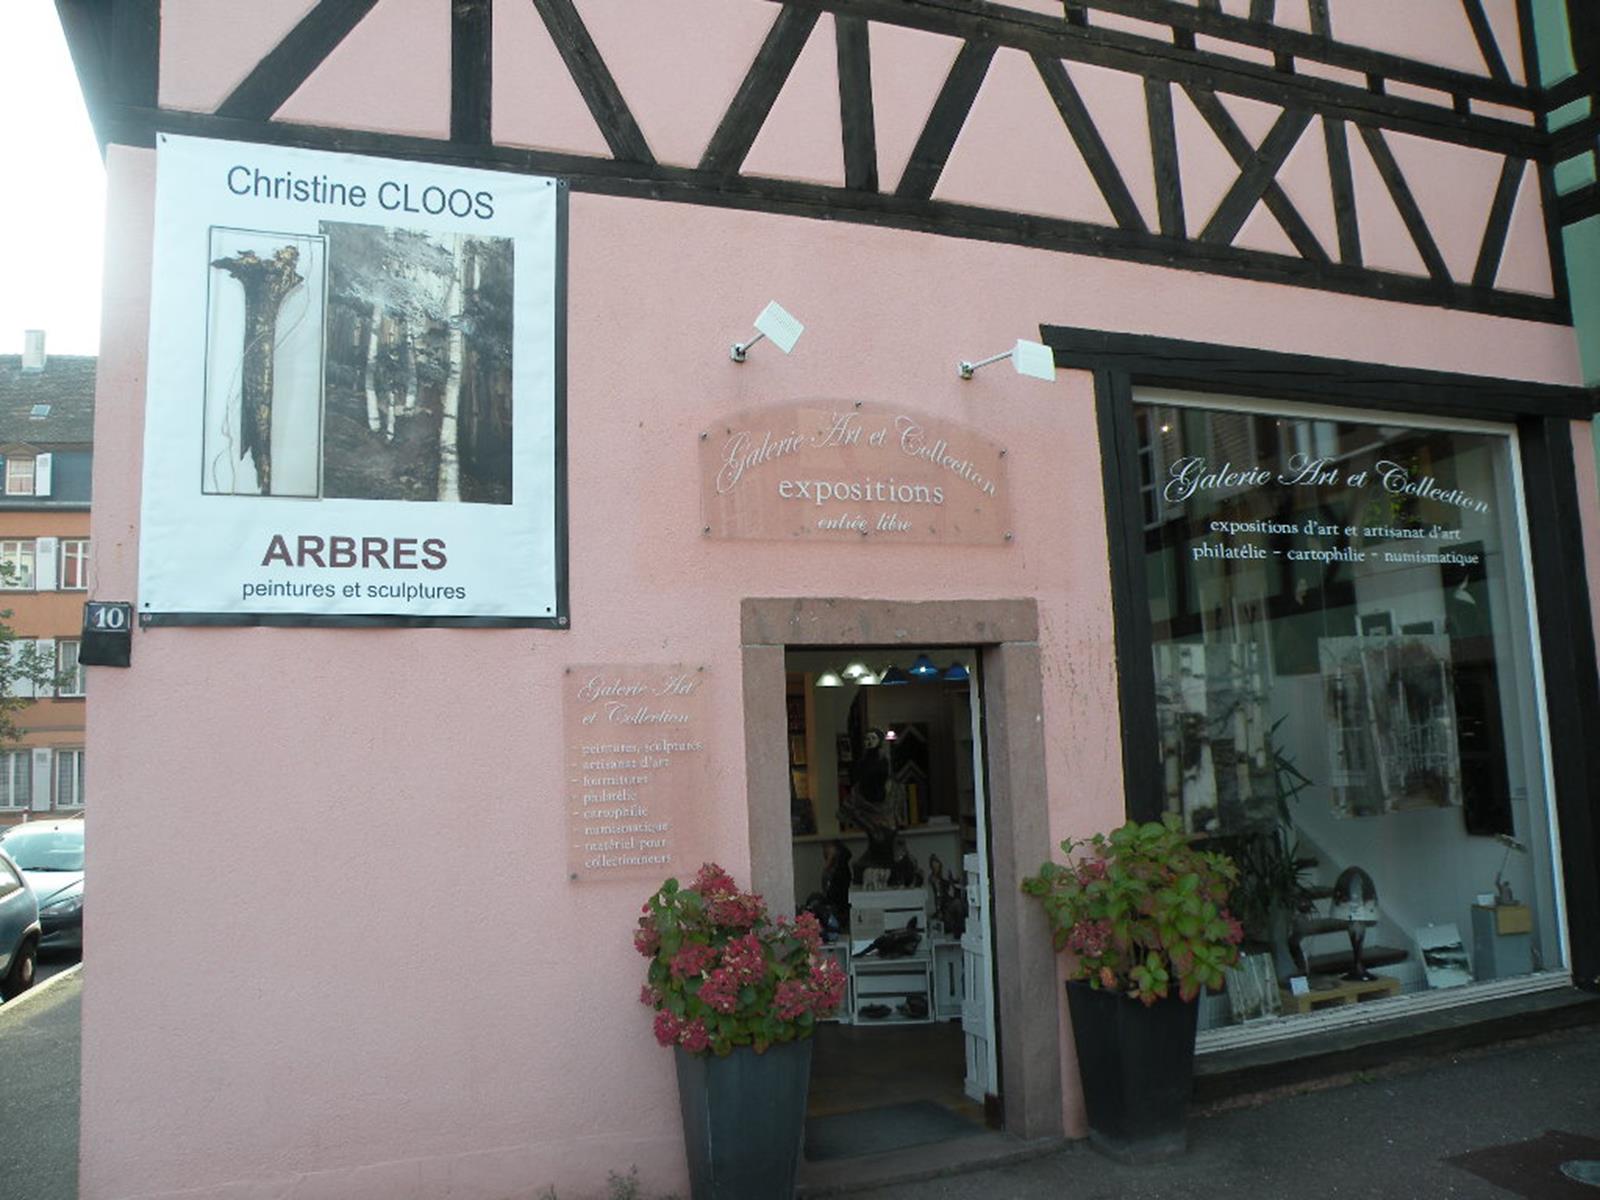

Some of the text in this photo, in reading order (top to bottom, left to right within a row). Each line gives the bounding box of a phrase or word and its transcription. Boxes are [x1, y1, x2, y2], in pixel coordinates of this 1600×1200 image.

[227, 165, 495, 220] Christine CLOOS
[716, 411, 997, 496] Galerie Art et Collection
[778, 477, 945, 505] expositions
[1163, 452, 1491, 514] Galerie Art et Collection
[817, 512, 913, 532] entrée libre
[1210, 519, 1461, 541] expositions d'art et artisanat d'art
[261, 534, 448, 571] ARBRES
[1192, 542, 1267, 560] philatélie
[1286, 544, 1365, 564] cartophilie
[1384, 547, 1480, 566] numismatique
[242, 578, 467, 603] peintures et sculptures
[95, 607, 124, 628] 10
[582, 710, 597, 725] et
